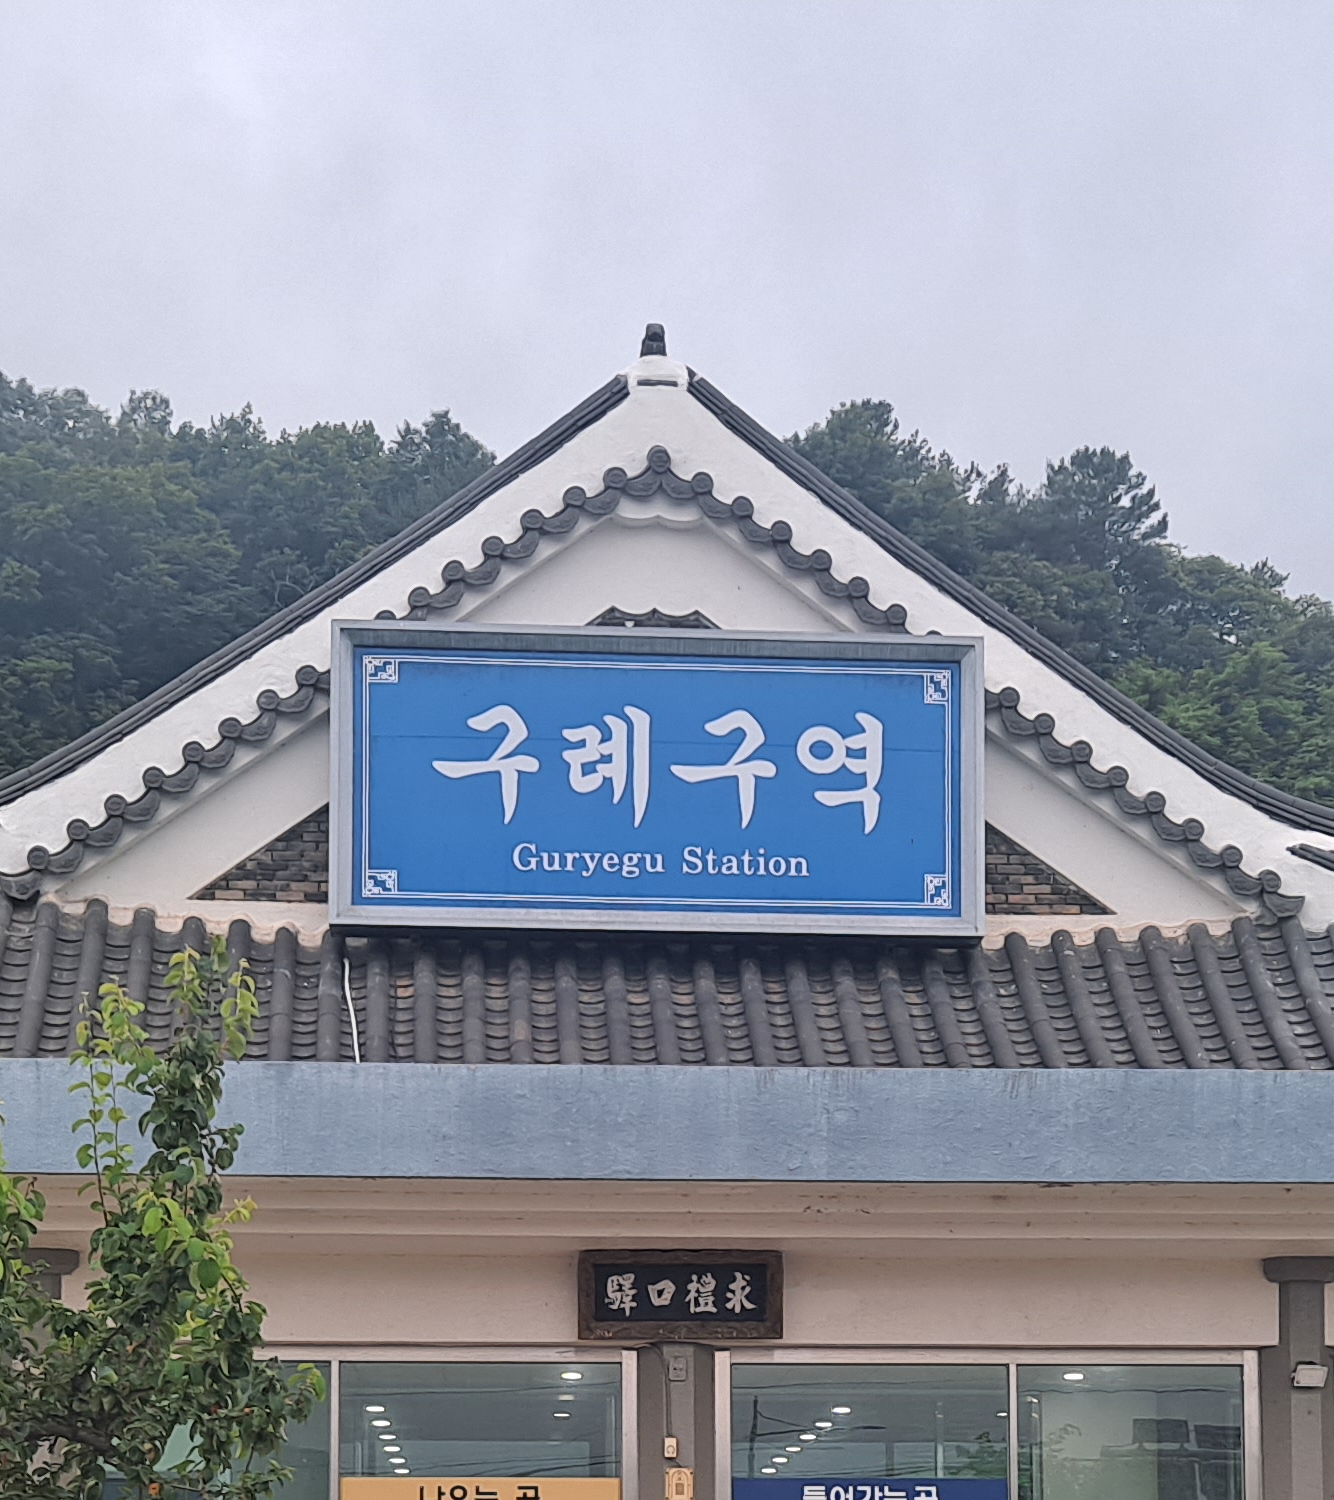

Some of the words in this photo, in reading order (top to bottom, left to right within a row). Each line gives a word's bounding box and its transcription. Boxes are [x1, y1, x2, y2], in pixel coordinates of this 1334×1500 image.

[432, 704, 884, 835] 구례구역
[512, 842, 665, 878] Guryegu
[682, 846, 810, 877] Station
